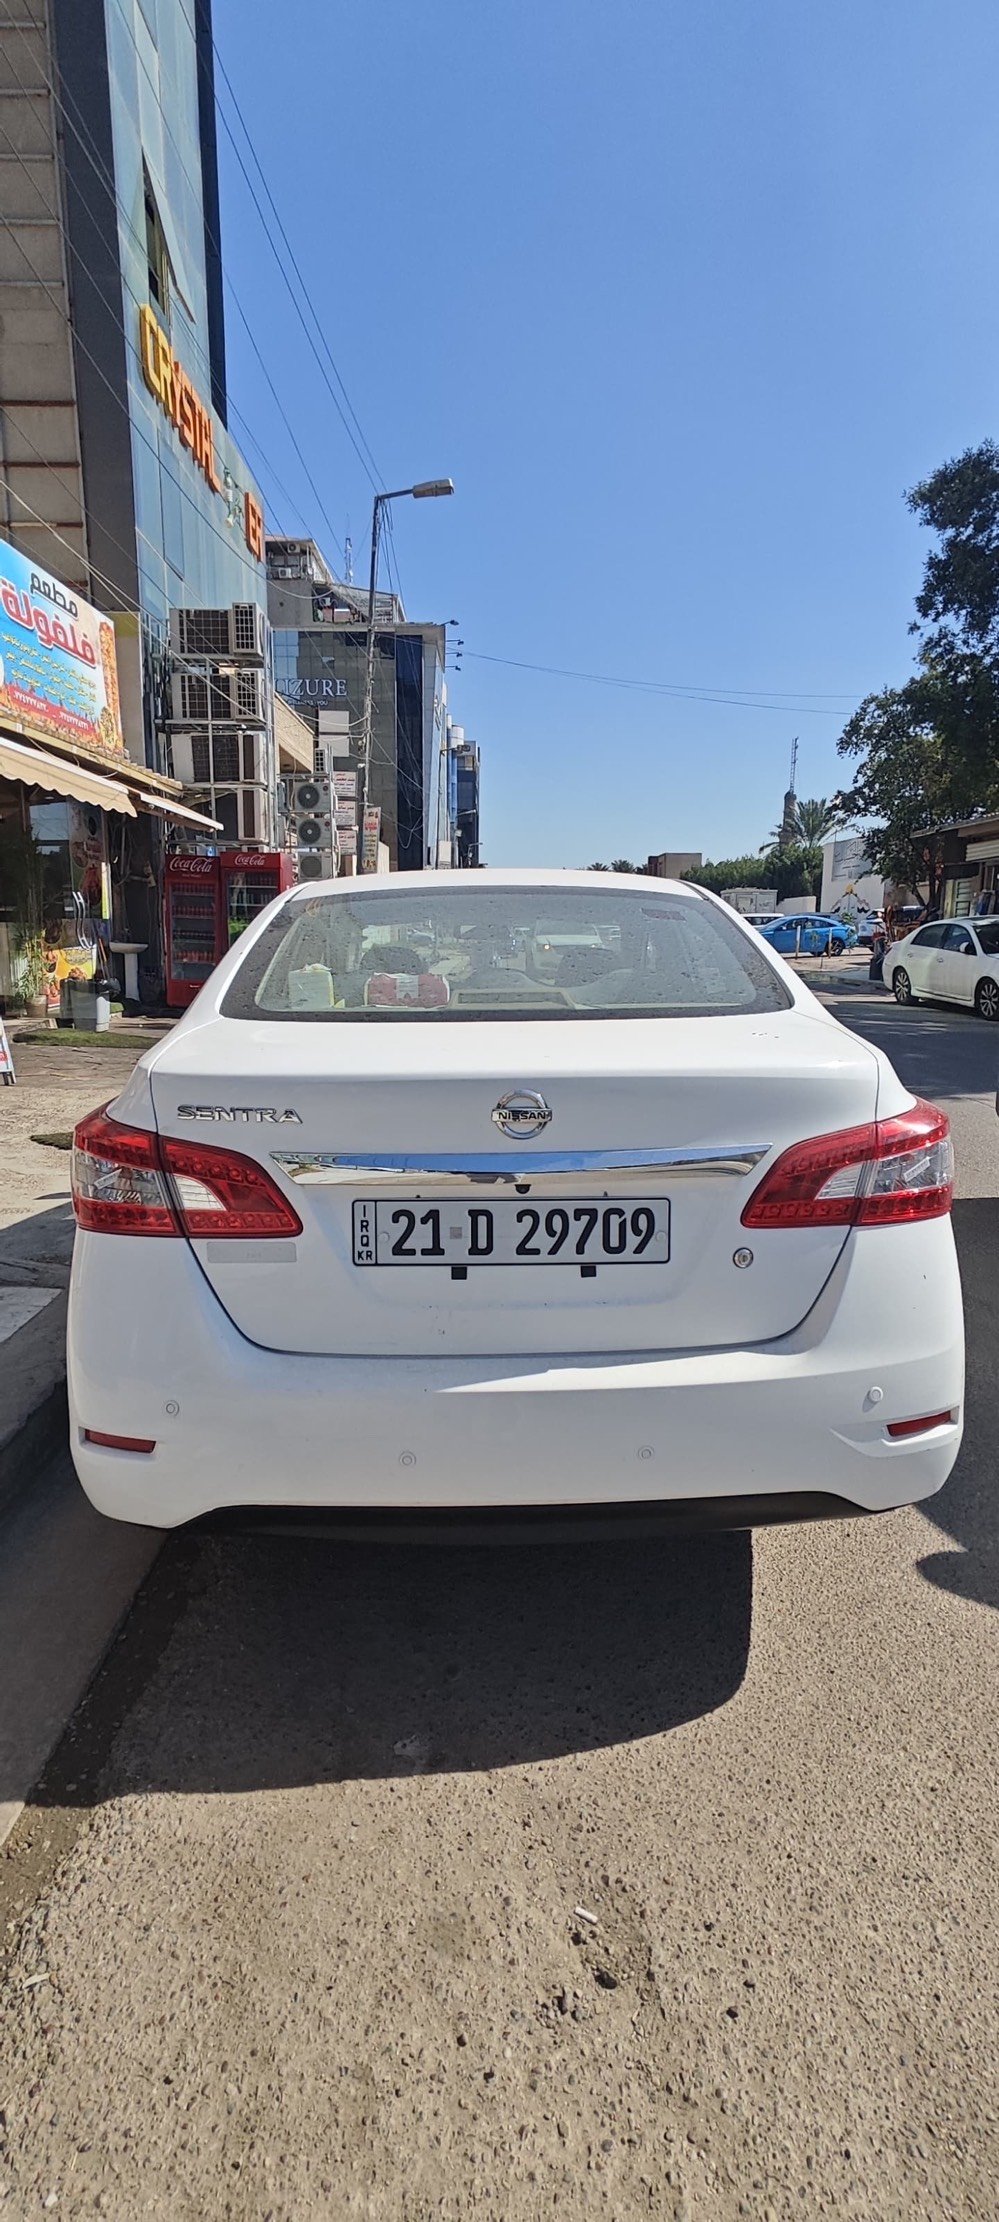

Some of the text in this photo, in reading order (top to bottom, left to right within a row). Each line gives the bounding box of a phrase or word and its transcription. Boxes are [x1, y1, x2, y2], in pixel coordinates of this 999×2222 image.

[140, 303, 221, 494] CRYSTAL
[30, 572, 78, 618] مطعم
[177, 1104, 303, 1124] SENTRA
[498, 1111, 546, 1121] NISSAN
[391, 1207, 656, 1256] 21 D 29709
[357, 1250, 373, 1261] KR
